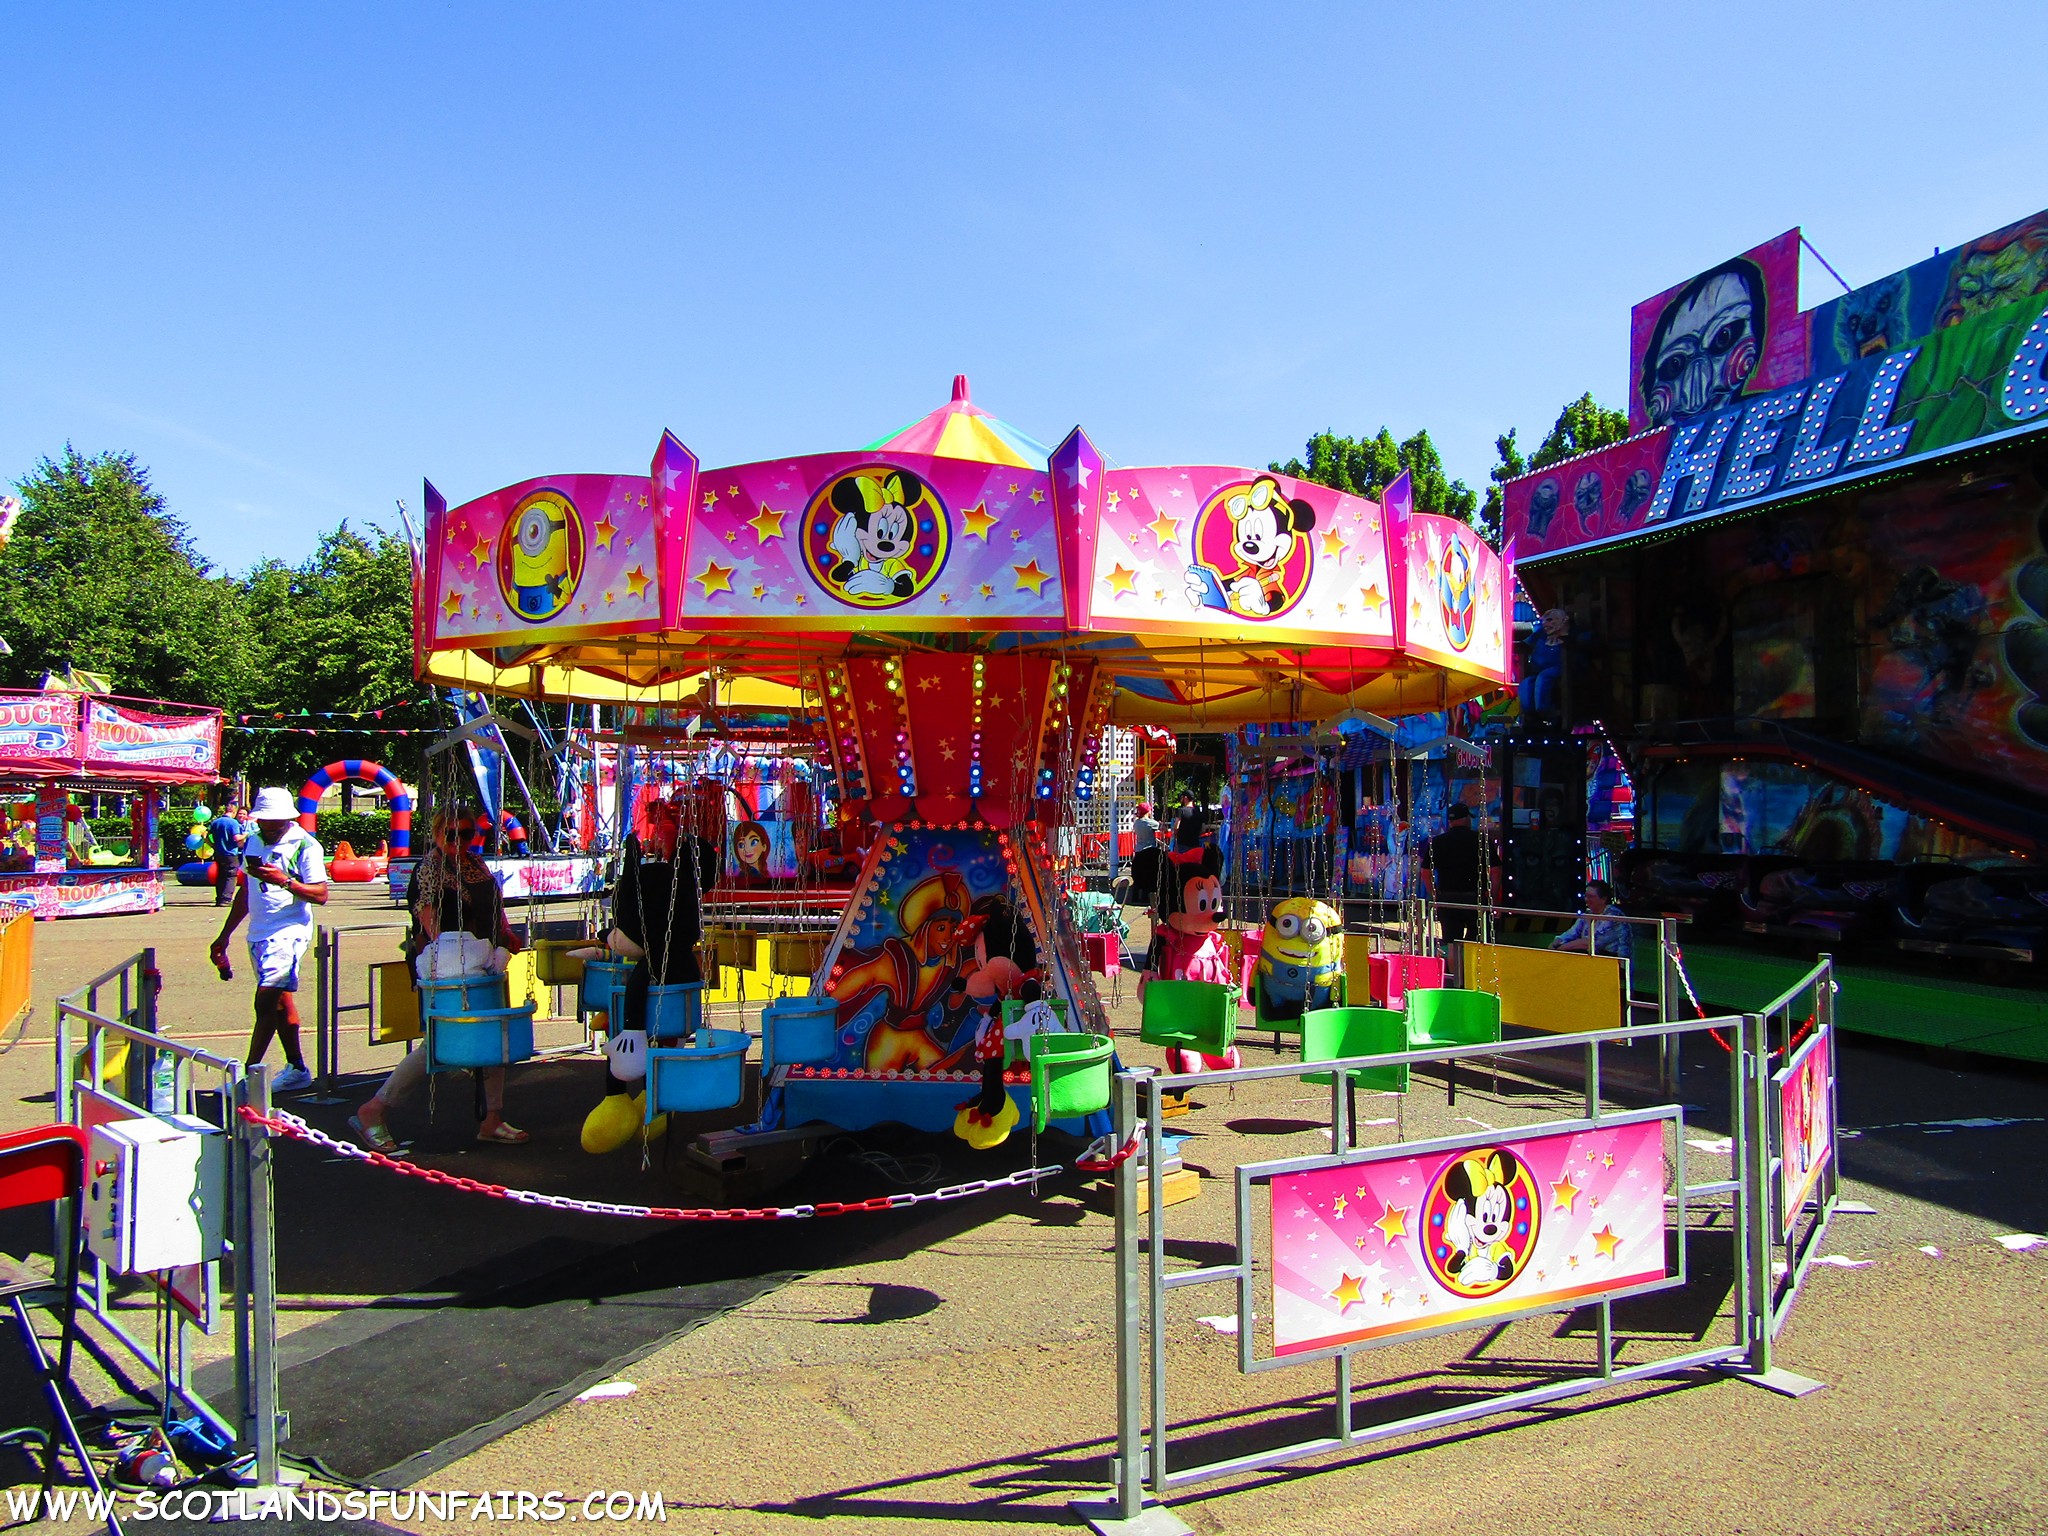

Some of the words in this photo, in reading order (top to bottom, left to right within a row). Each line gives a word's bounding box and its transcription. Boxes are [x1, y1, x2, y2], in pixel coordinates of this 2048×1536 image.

[1645, 347, 1919, 522] HELL
[0, 704, 71, 726] DUCK
[95, 721, 154, 743] HOOK
[0, 878, 40, 894] UCK
[57, 882, 106, 902] HOOK
[108, 879, 118, 894] A
